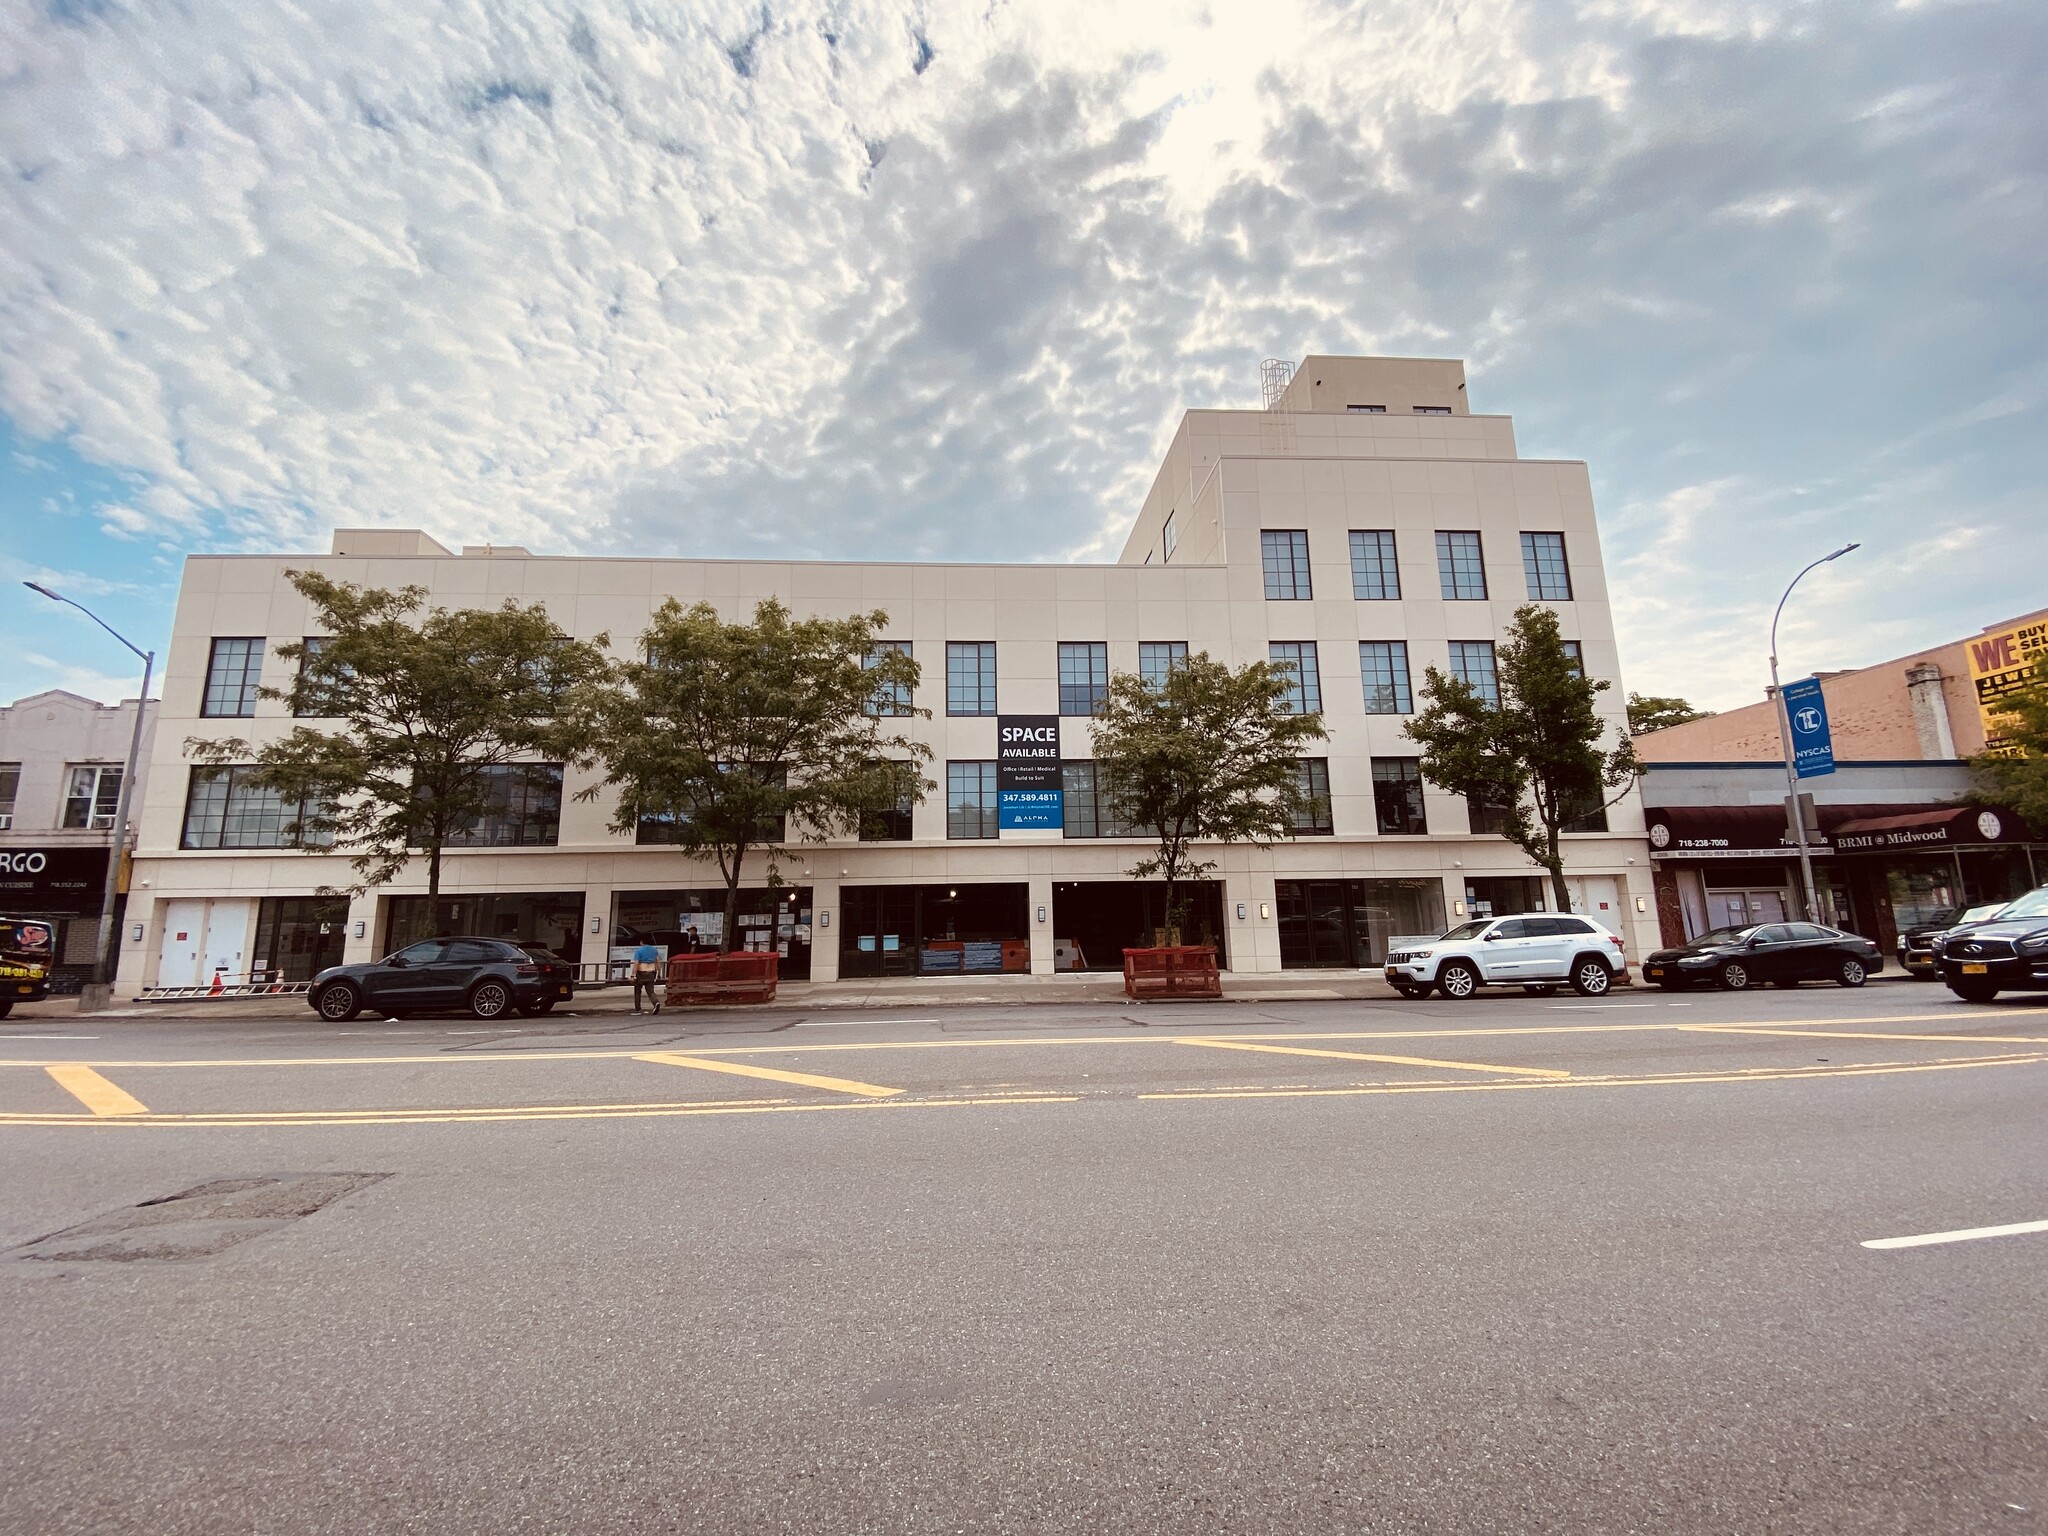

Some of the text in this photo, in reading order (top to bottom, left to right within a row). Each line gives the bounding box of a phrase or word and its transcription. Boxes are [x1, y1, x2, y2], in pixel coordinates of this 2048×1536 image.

[2018, 623, 2046, 639] BUY
[1972, 634, 2020, 673] WE
[1002, 727, 1056, 742] SPACE
[1002, 748, 1056, 758] AVAILABLE
[1796, 745, 1831, 758] NYSCAS
[1003, 793, 1058, 802] 347.589.4811
[1678, 839, 1729, 847] 718-238-7000
[1836, 827, 1947, 848] BRMI @ Midwood
[0, 852, 46, 873] RGO
